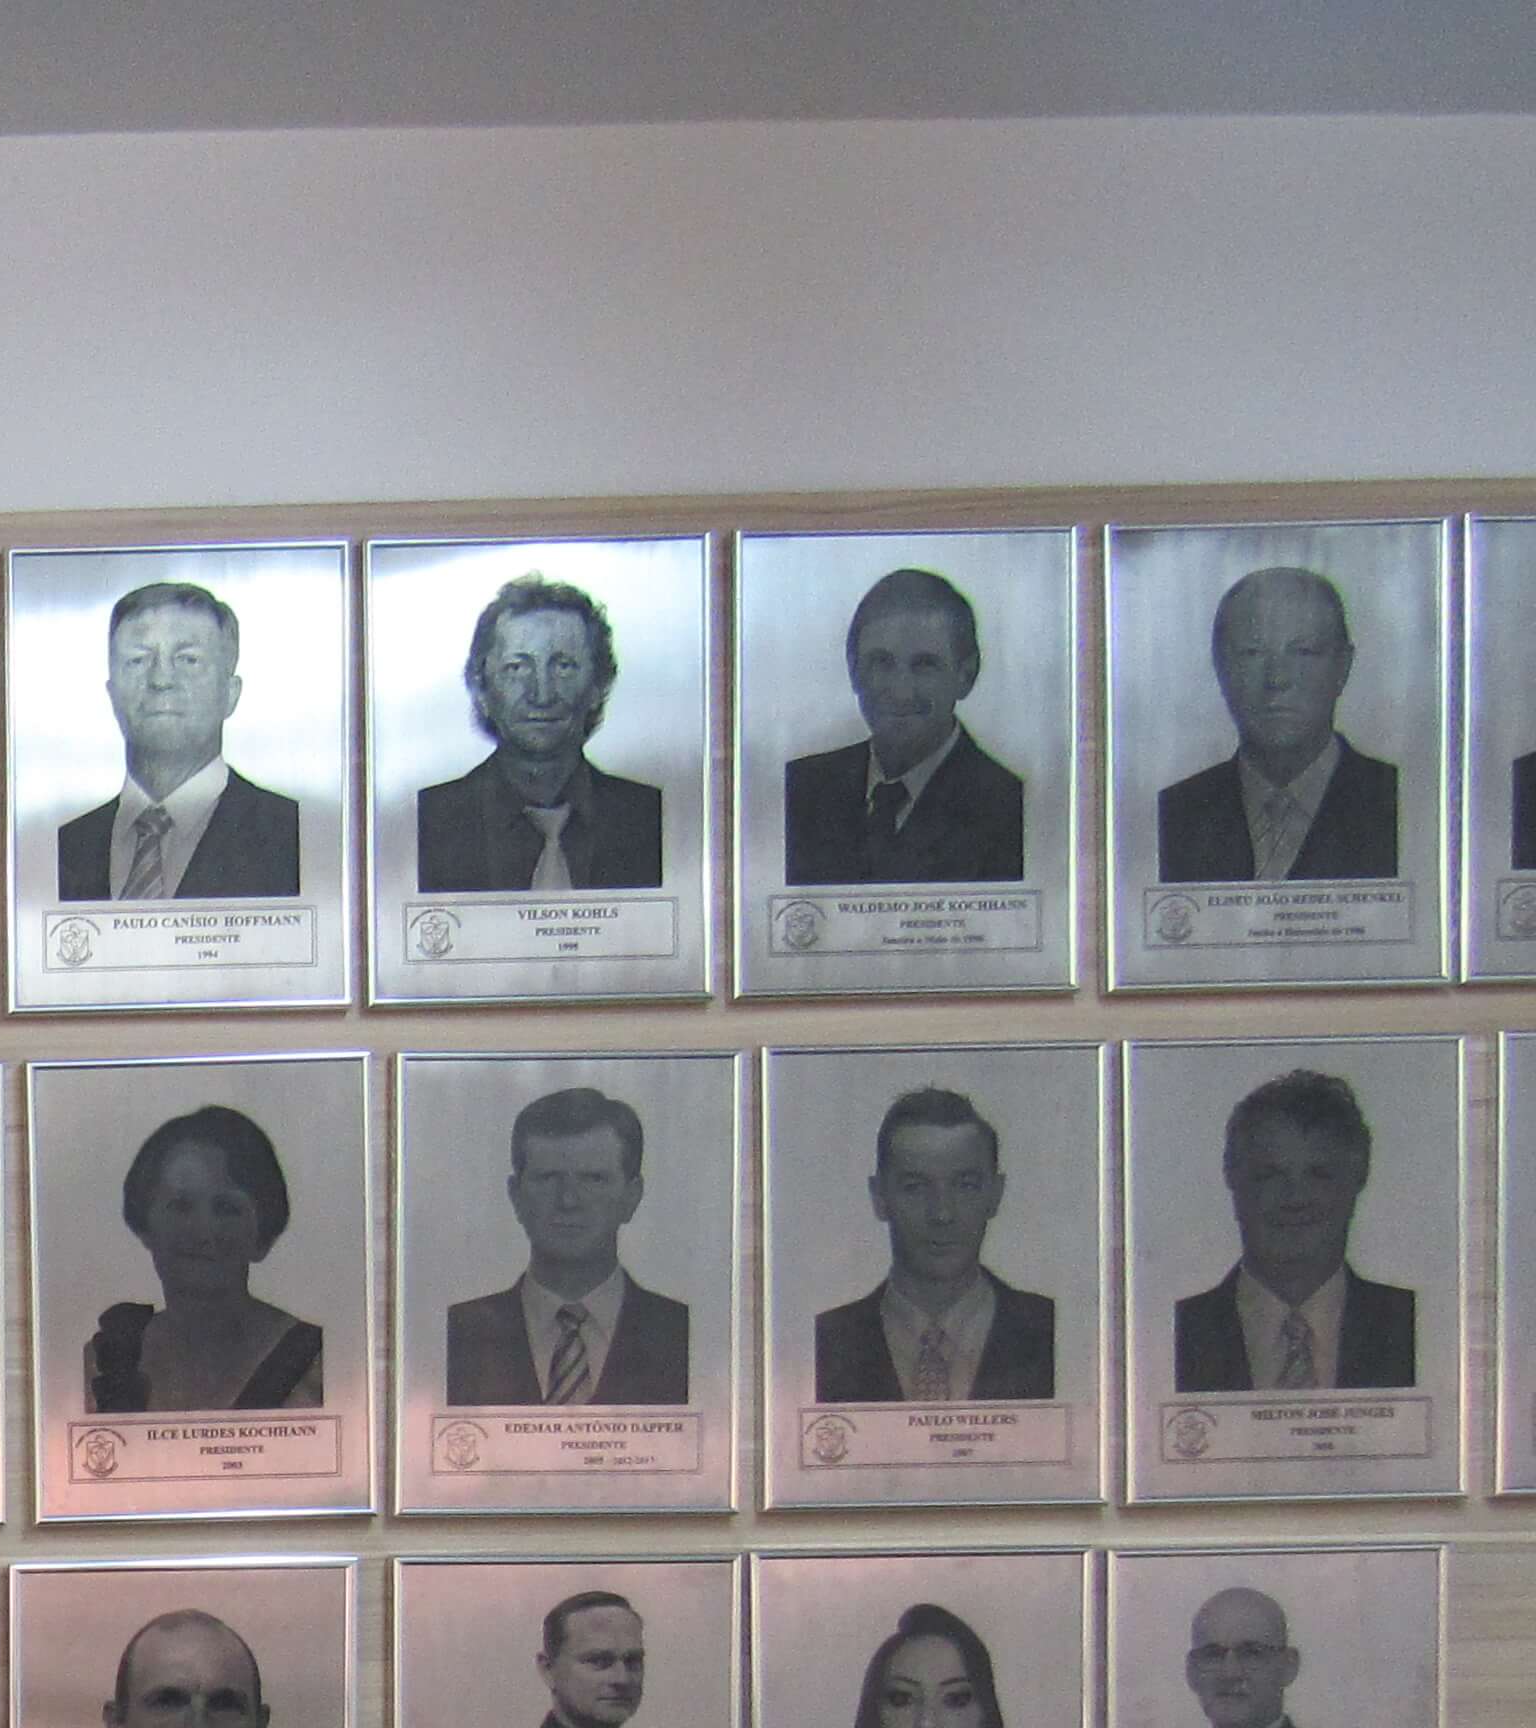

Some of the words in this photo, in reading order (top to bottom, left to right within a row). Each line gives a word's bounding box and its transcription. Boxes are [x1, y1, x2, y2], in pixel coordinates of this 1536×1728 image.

[913, 899, 943, 912] JOSÉ
[518, 909, 568, 920] VILSON
[572, 908, 618, 919] KOHLS
[113, 919, 158, 929] PAULO
[162, 914, 217, 928] CANÍSIO
[224, 915, 301, 927] HOFFMANN
[900, 920, 966, 929] PRESIDENTE
[535, 927, 601, 936] PRESIDENTE
[174, 935, 240, 944] PRESIDENTE
[505, 1423, 562, 1434] EDEMAR
[567, 1420, 627, 1433] ANTÔNIO
[631, 1423, 683, 1433] DAPPER
[147, 1429, 178, 1440] ILCE
[182, 1427, 235, 1440] LURDES
[239, 1426, 316, 1438] KOCHHANN
[200, 1445, 264, 1455] PRESIDENTE
[561, 1440, 626, 1450] PRESIDENTE
